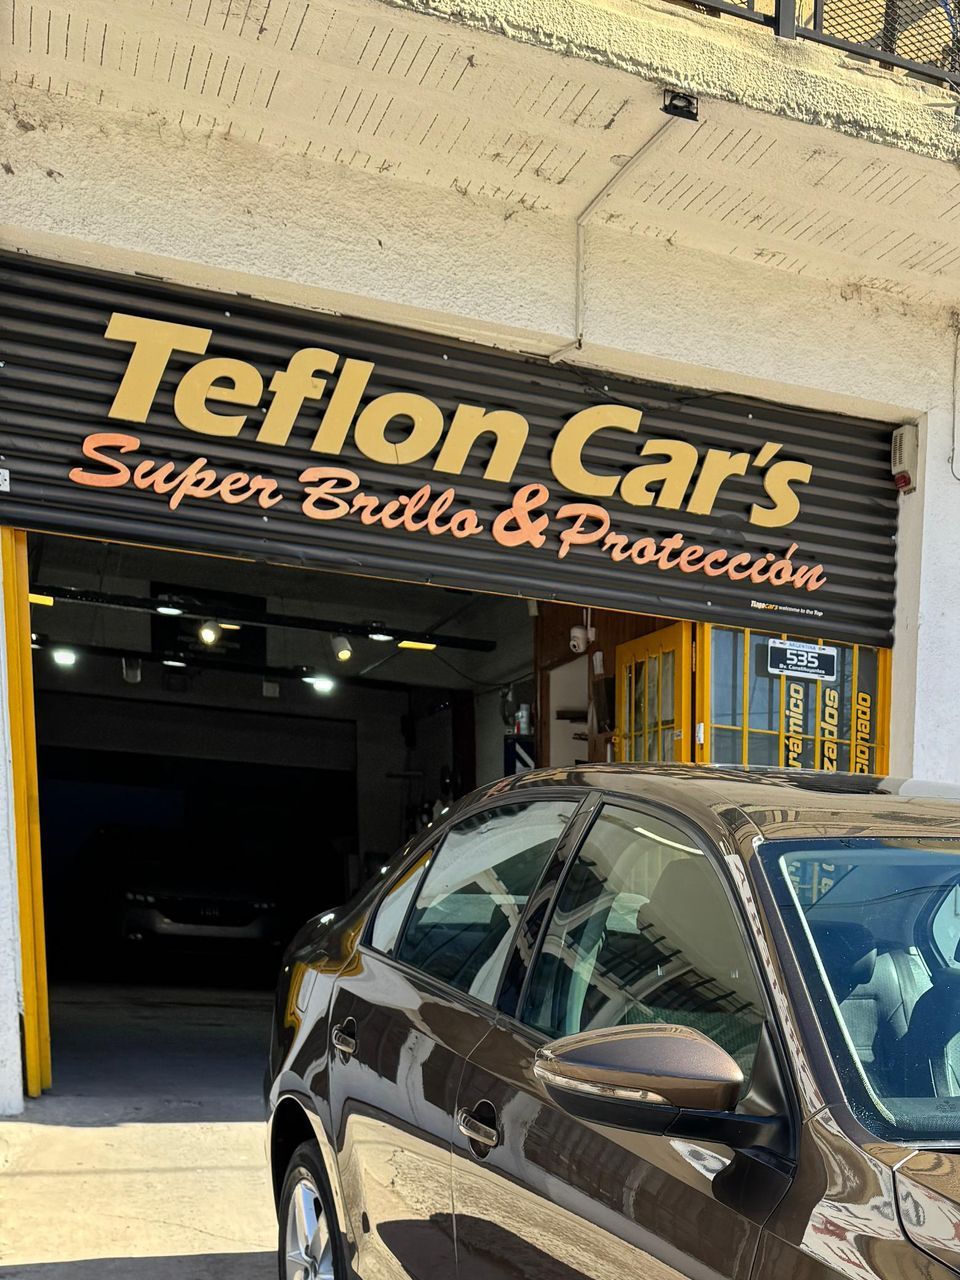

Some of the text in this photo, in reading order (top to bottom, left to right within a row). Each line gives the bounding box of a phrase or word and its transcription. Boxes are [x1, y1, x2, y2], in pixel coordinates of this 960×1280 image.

[105, 312, 812, 529] Teflon Car's
[69, 433, 827, 592] Super Brillo & Protección
[786, 649, 819, 668] 535
